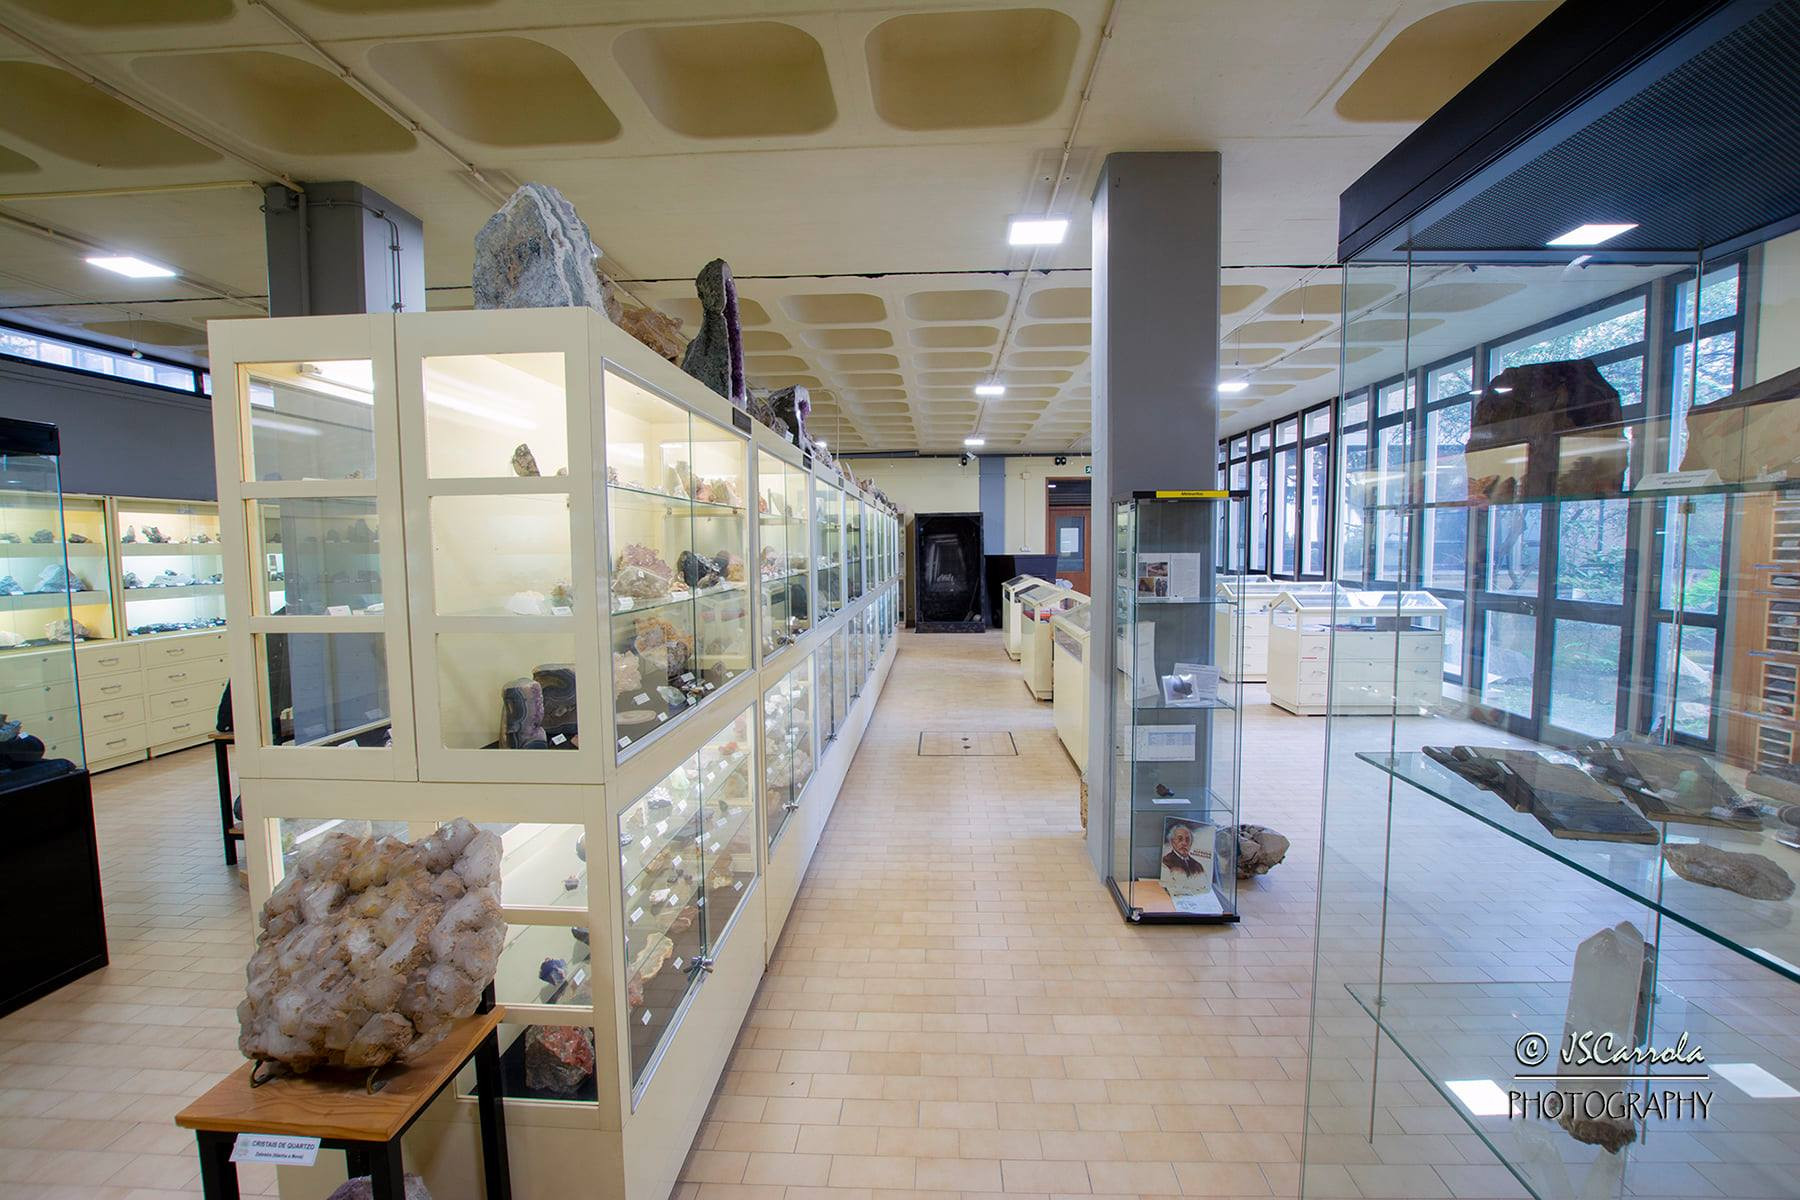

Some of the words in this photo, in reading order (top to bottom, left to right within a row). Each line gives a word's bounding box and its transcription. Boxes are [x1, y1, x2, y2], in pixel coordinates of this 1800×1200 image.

[252, 1140, 277, 1148] CRISTAIS
[278, 1141, 286, 1149] DE
[286, 1142, 315, 1150] QUARTZO
